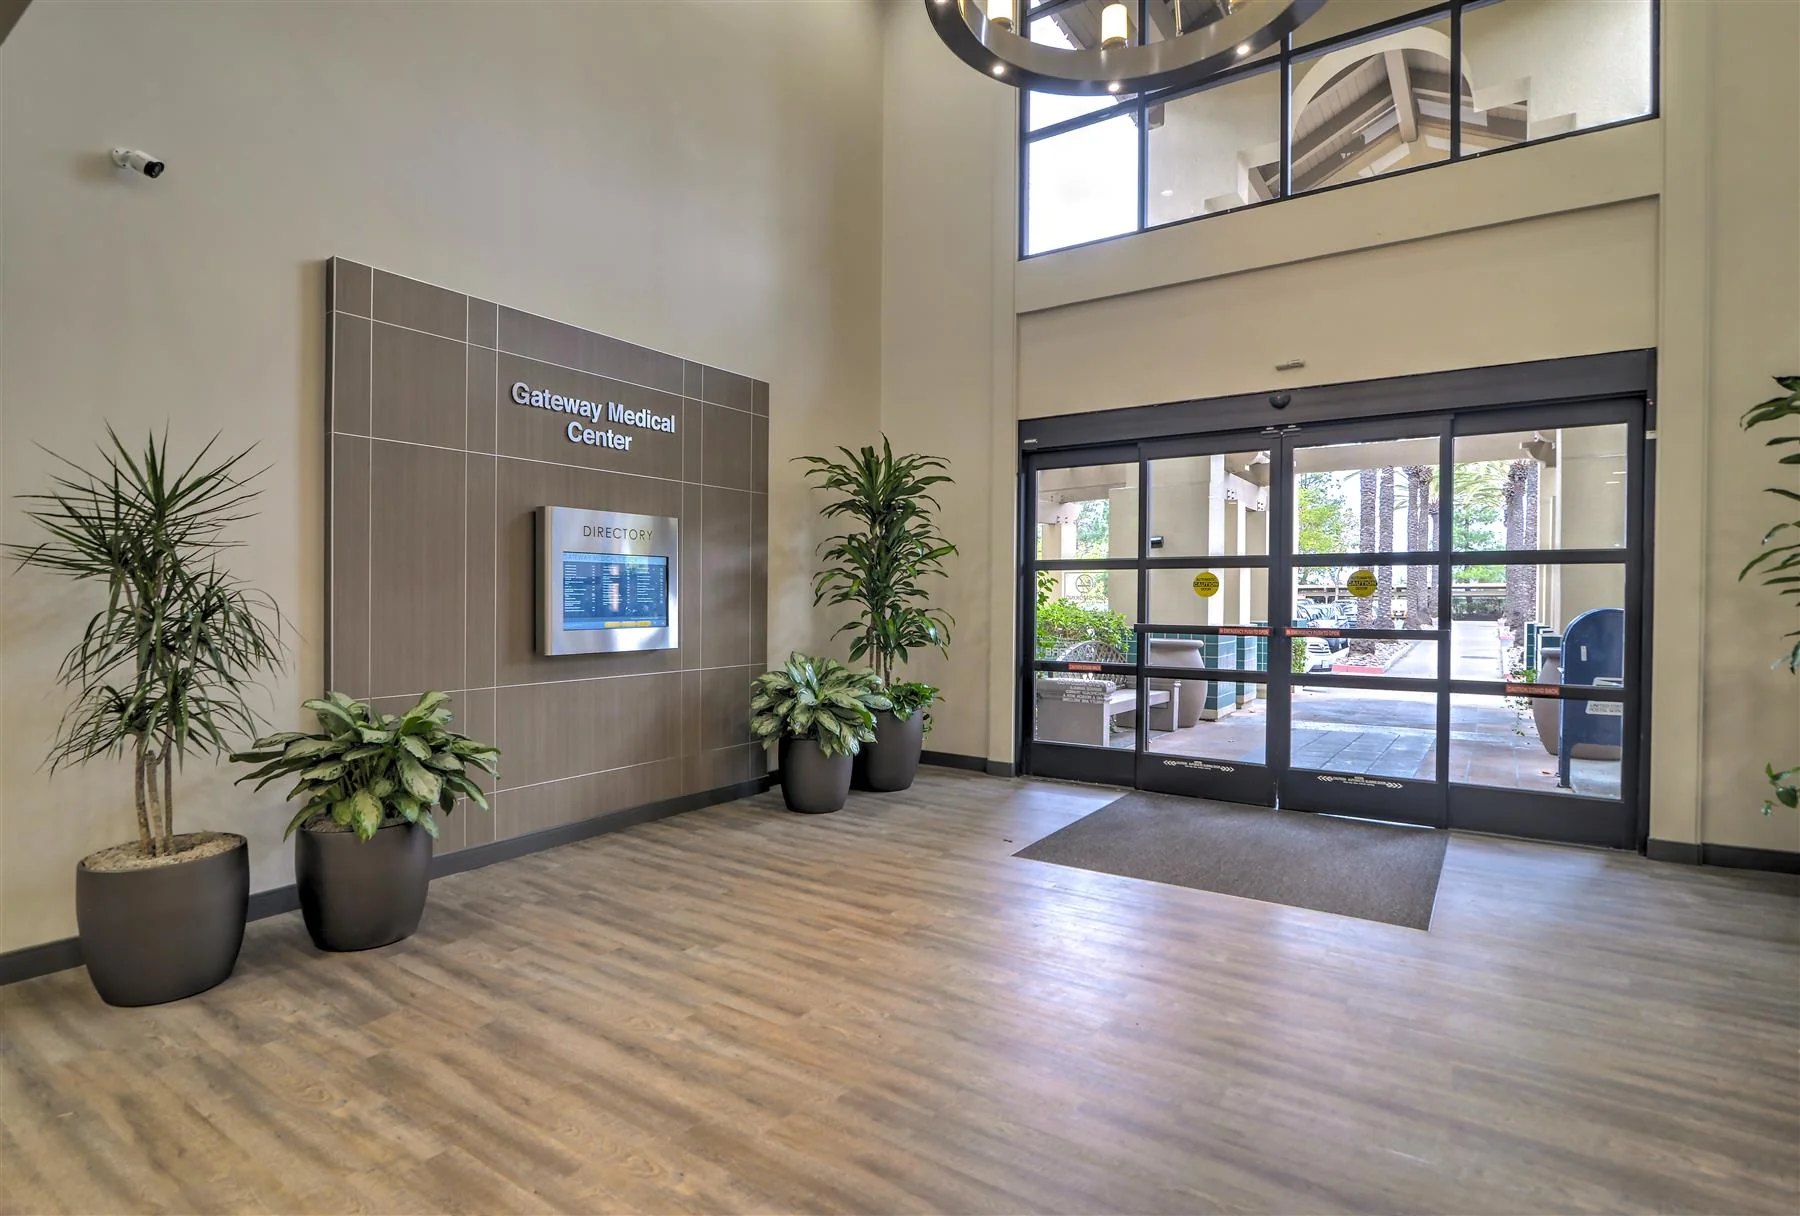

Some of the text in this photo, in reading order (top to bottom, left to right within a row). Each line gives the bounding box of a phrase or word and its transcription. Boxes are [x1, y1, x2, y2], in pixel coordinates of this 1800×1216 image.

[511, 382, 675, 433] Gateway Medical
[567, 421, 632, 450] Center
[583, 525, 653, 541] DIRECTORY
